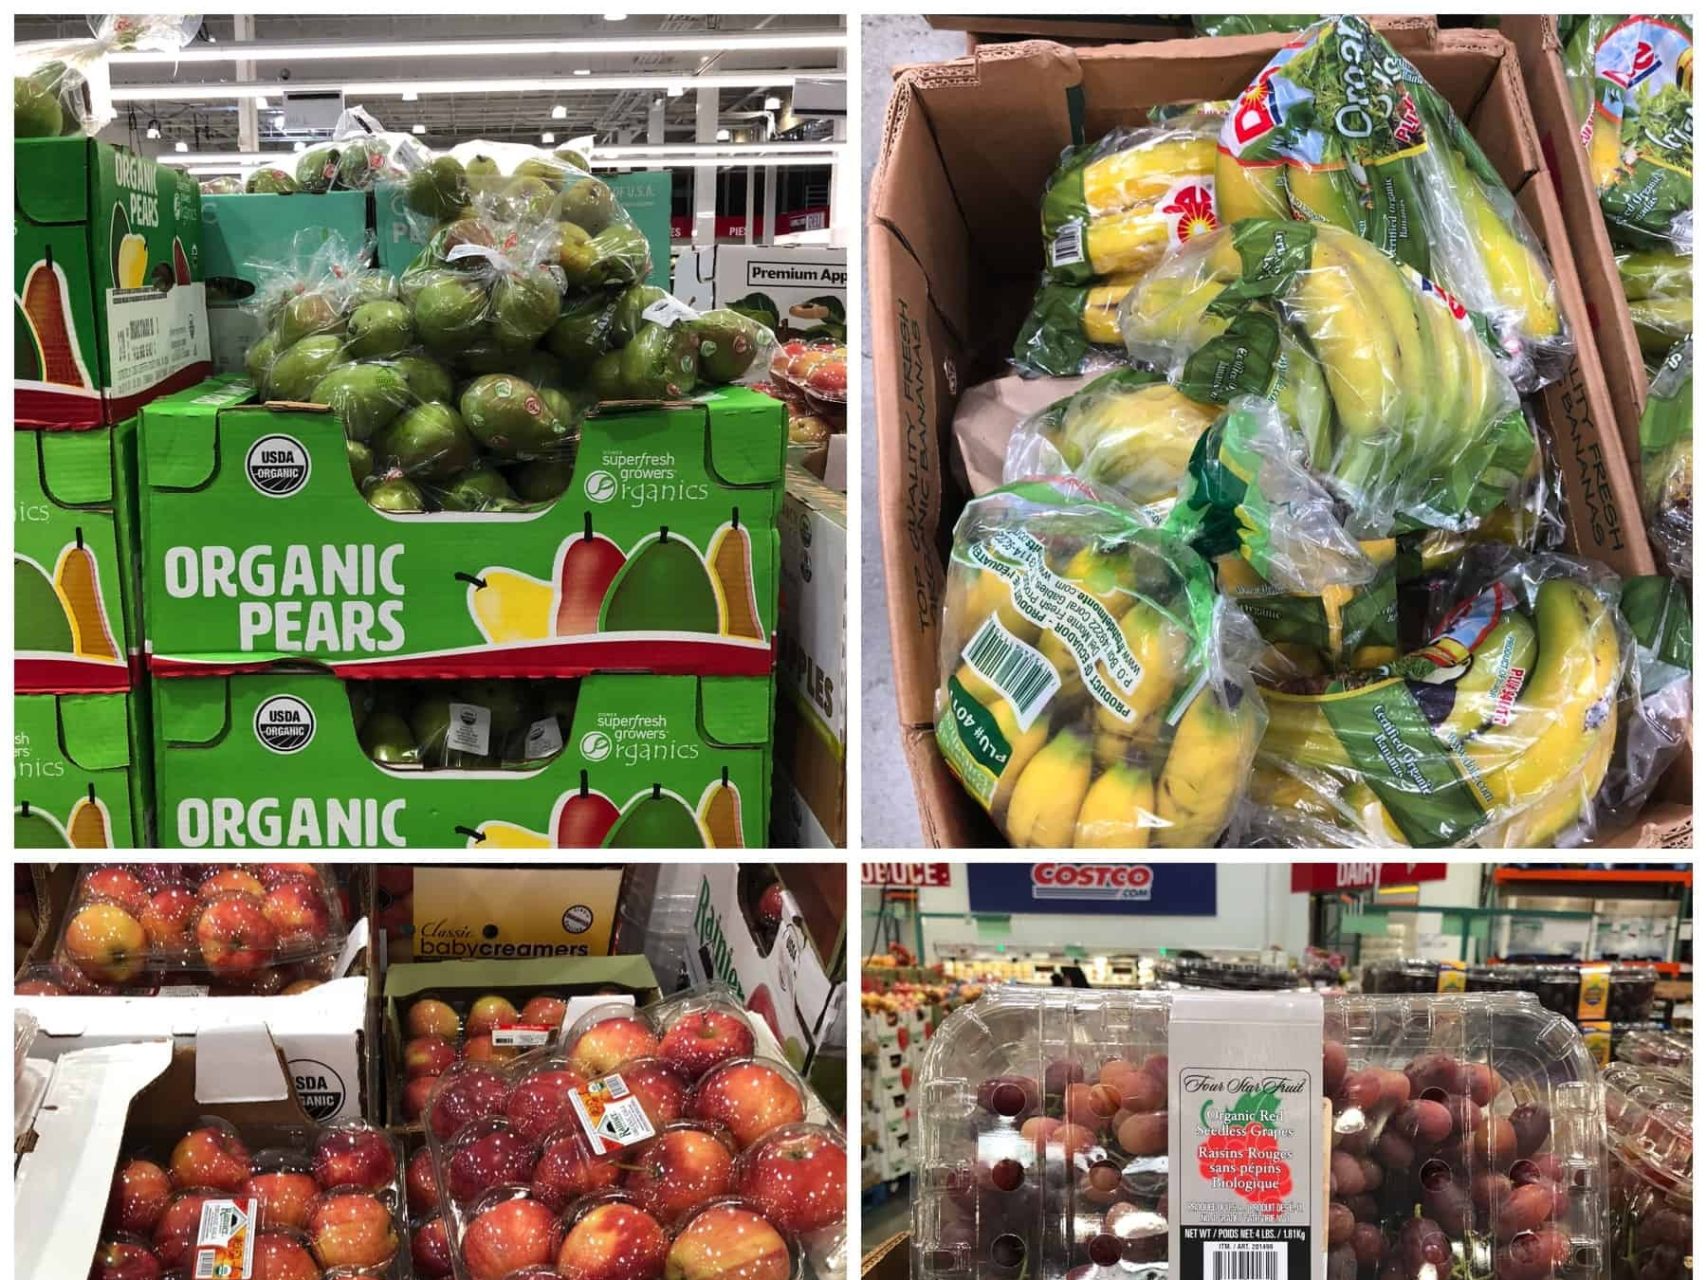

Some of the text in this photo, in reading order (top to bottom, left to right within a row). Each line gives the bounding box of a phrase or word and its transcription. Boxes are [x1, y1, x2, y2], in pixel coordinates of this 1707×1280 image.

[130, 193, 159, 228] PEARS
[752, 266, 818, 281] Premium
[897, 297, 915, 403] FRESH
[911, 318, 929, 472] BANANAS
[261, 450, 295, 464] USDA
[602, 452, 675, 469] superfresh
[1560, 393, 1604, 545] BANANAS
[258, 466, 300, 479] ORGANIC
[620, 465, 676, 482] growers
[1587, 442, 1625, 552] FRESH
[164, 544, 406, 598] ORGANIC
[1038, 597, 1067, 621] Fresh
[1063, 598, 1092, 624] Coral
[240, 600, 406, 652] PEARS
[1064, 615, 1091, 642] Monte
[1053, 621, 1092, 663] ECUADOR
[1090, 673, 1132, 718] PRODUCT
[269, 710, 300, 723] USDA
[597, 712, 667, 730] superfresh
[265, 725, 305, 738] ORGANIC
[615, 726, 667, 743] growers
[974, 726, 1006, 762] PLU#
[1373, 704, 1431, 796] Certified Organic
[1374, 734, 1405, 778] Bananas
[177, 798, 407, 848] ORGANIC
[1033, 863, 1153, 887] COSTCO
[1336, 863, 1383, 887] DAIRY
[420, 918, 476, 939] Classic
[420, 934, 588, 958] babycreamers
[1184, 1074, 1307, 1094] Four Star Fruit
[1207, 1109, 1284, 1125] Organic Red
[1196, 1124, 1294, 1140] Seedless Grapes
[1198, 1147, 1293, 1161] Raisins Rouges
[1209, 1162, 1282, 1176] sans pépins
[1211, 1176, 1280, 1193] Biologique
[1184, 1228, 1198, 1238] NET
[1199, 1228, 1211, 1238] WT
[1218, 1228, 1239, 1238] POIDS
[1255, 1228, 1260, 1238] 4
